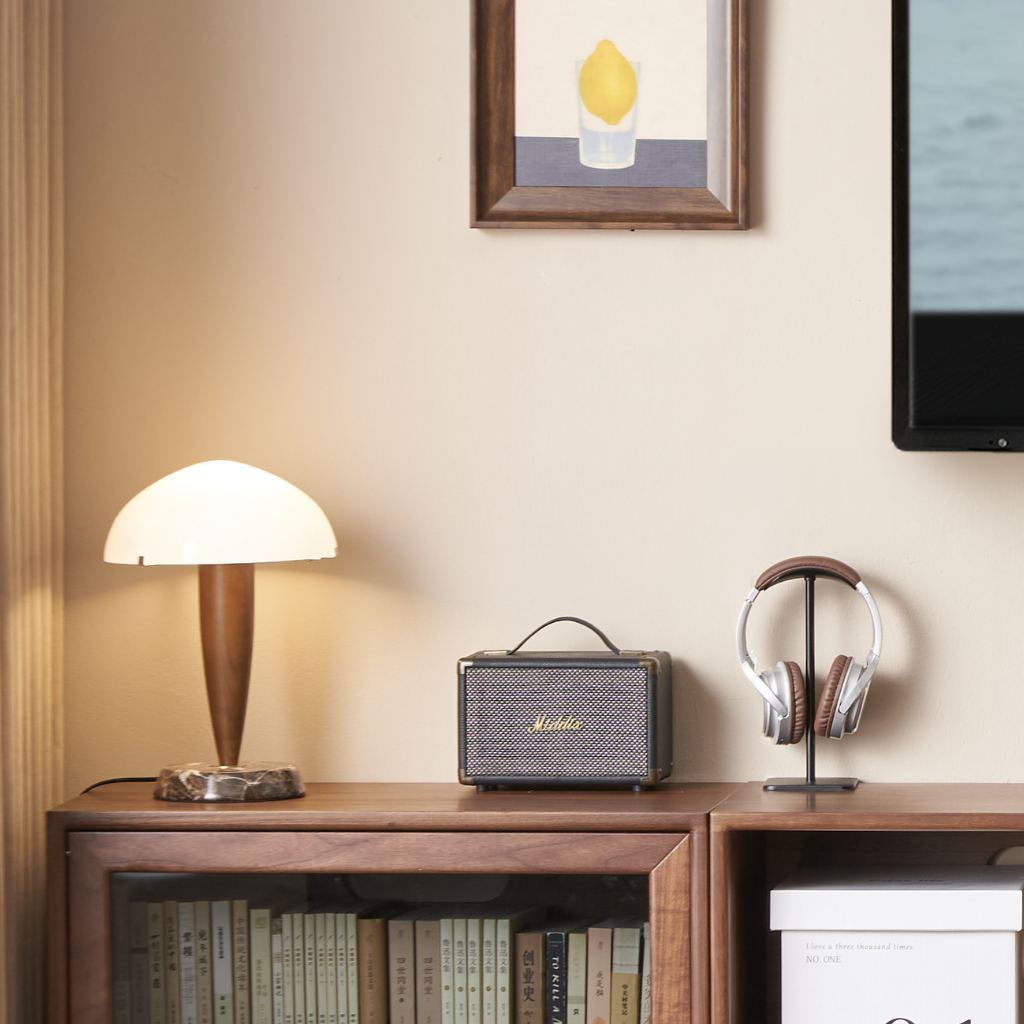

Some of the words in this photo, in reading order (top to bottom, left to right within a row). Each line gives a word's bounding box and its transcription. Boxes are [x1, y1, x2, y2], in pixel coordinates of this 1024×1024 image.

[552, 957, 560, 970] TO
[806, 955, 821, 963] NO.
[823, 955, 842, 963] ONE
[397, 958, 406, 995] 四世同堂
[424, 958, 433, 995] 四世同堂
[522, 950, 535, 1002] 创业史
[552, 974, 560, 1001] KILL
